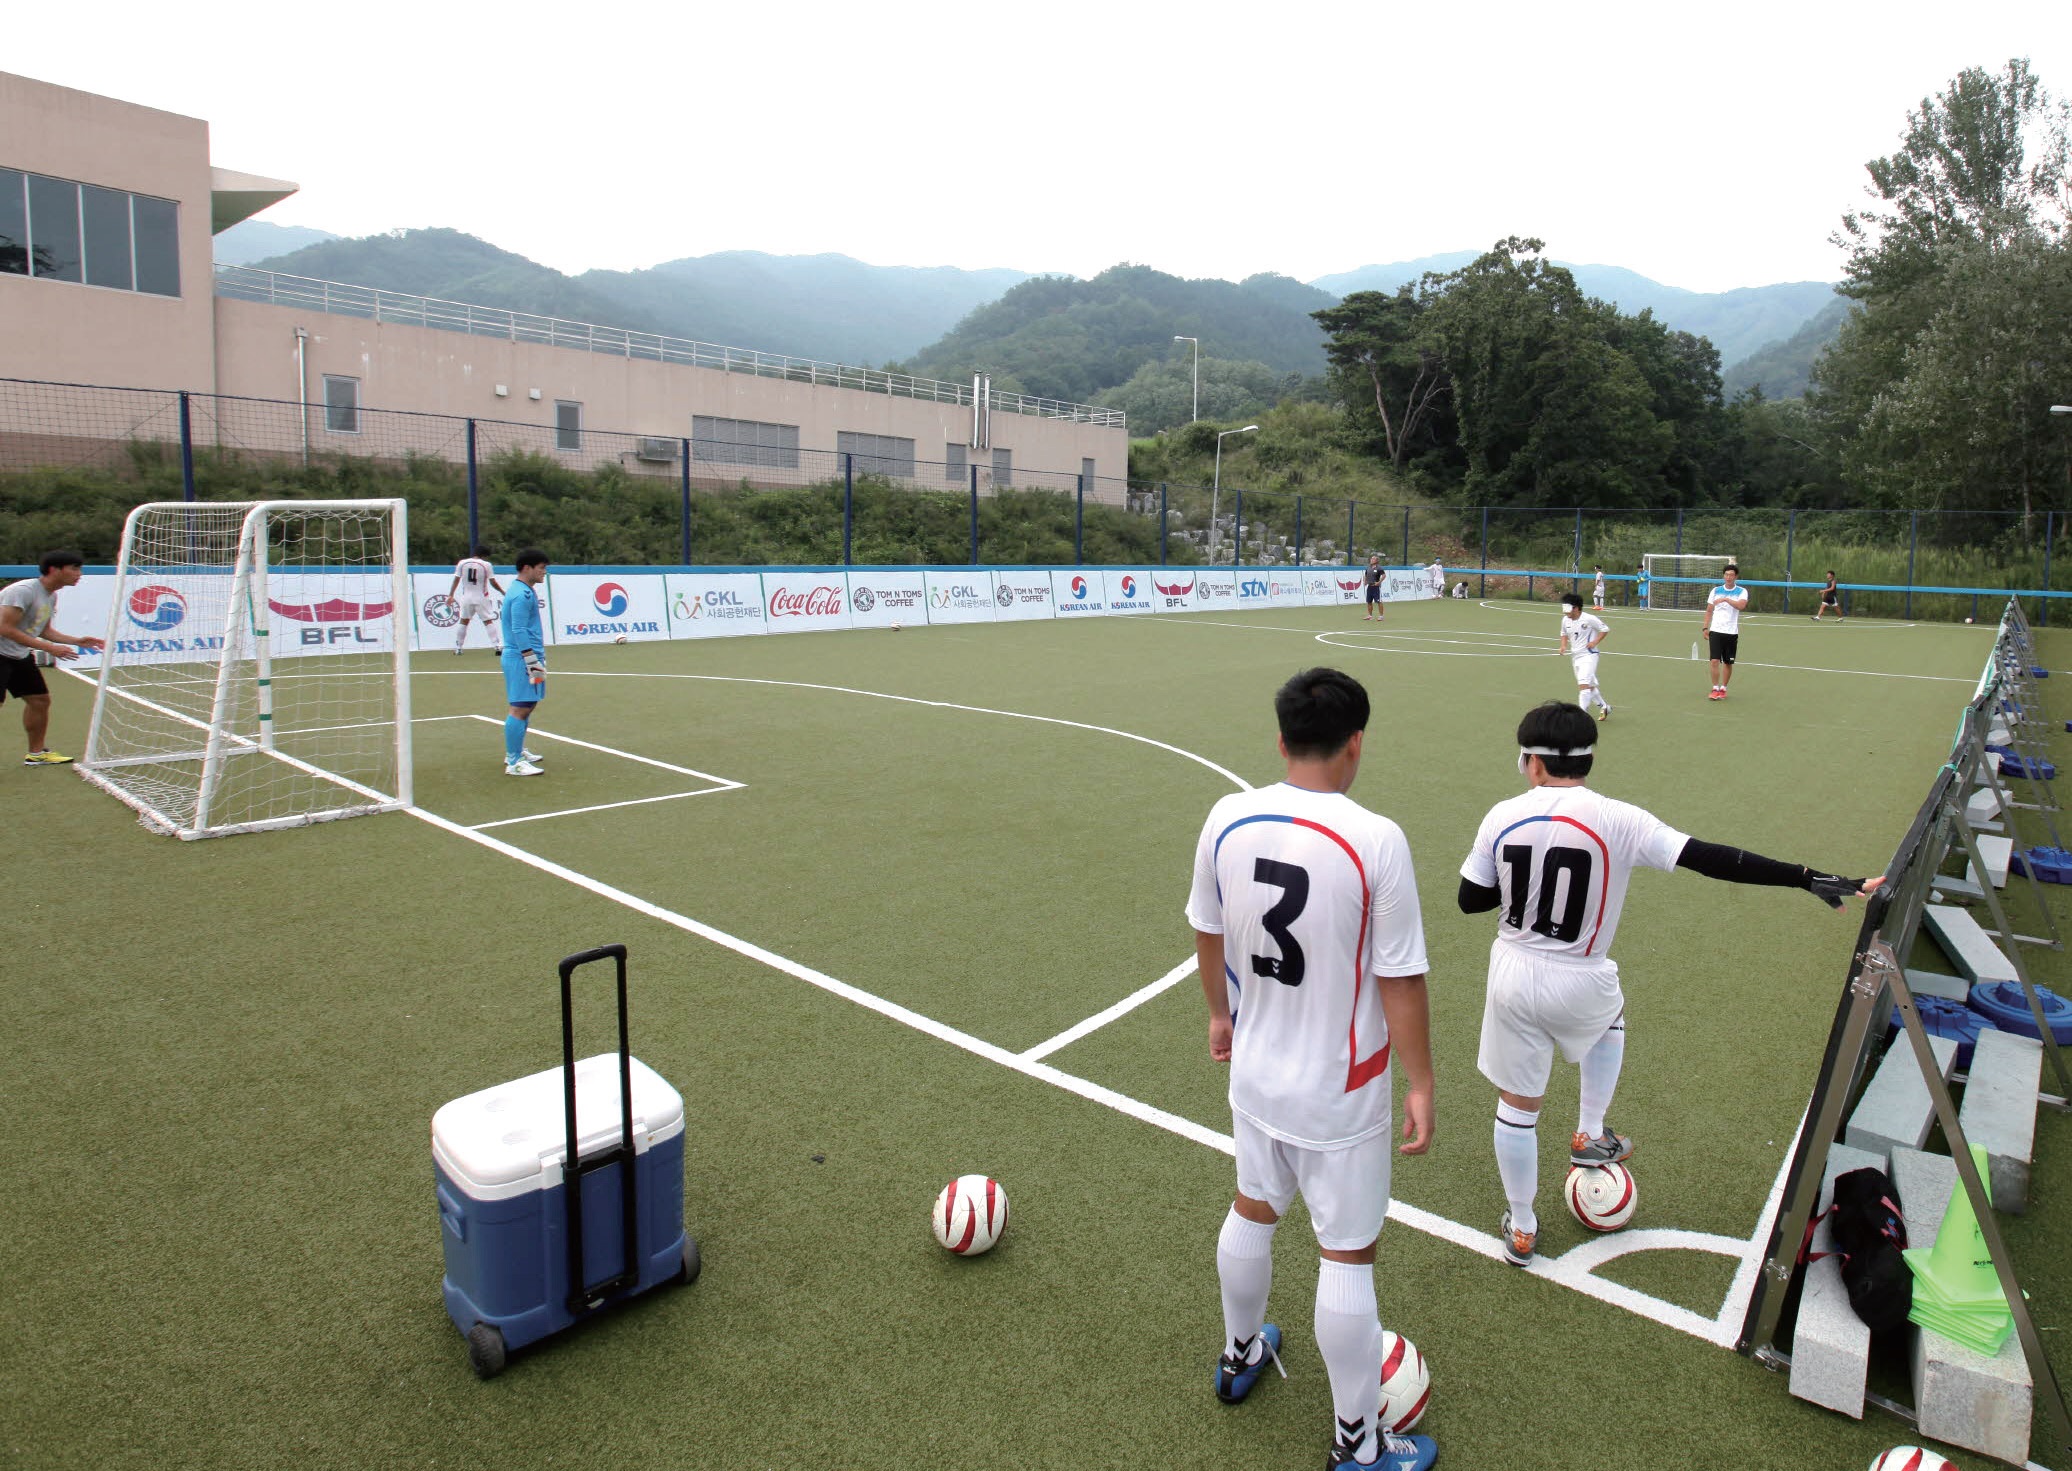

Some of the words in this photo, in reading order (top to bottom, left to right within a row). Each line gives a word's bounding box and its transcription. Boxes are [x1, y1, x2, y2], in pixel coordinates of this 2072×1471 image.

[468, 568, 477, 585] 4
[876, 590, 892, 599] TOM
[895, 590, 900, 598] N
[902, 590, 922, 598] TOMS
[951, 585, 979, 598] GKL
[1034, 587, 1050, 595] TOMS
[1344, 592, 1358, 600] BFL
[704, 590, 744, 606] GKL
[885, 599, 914, 607] COFFEE
[1020, 595, 1044, 603] COFFEE
[1166, 598, 1188, 608] BFL
[1089, 602, 1103, 611] AIR
[1138, 601, 1151, 609] AIR
[707, 606, 761, 619] 사회공헌재단
[565, 622, 628, 636] KOREAN
[630, 621, 660, 633] AIR
[301, 626, 378, 645] BFL
[1574, 632, 1579, 641] 7
[1502, 844, 1593, 943] 10
[1250, 857, 1310, 987] 3
